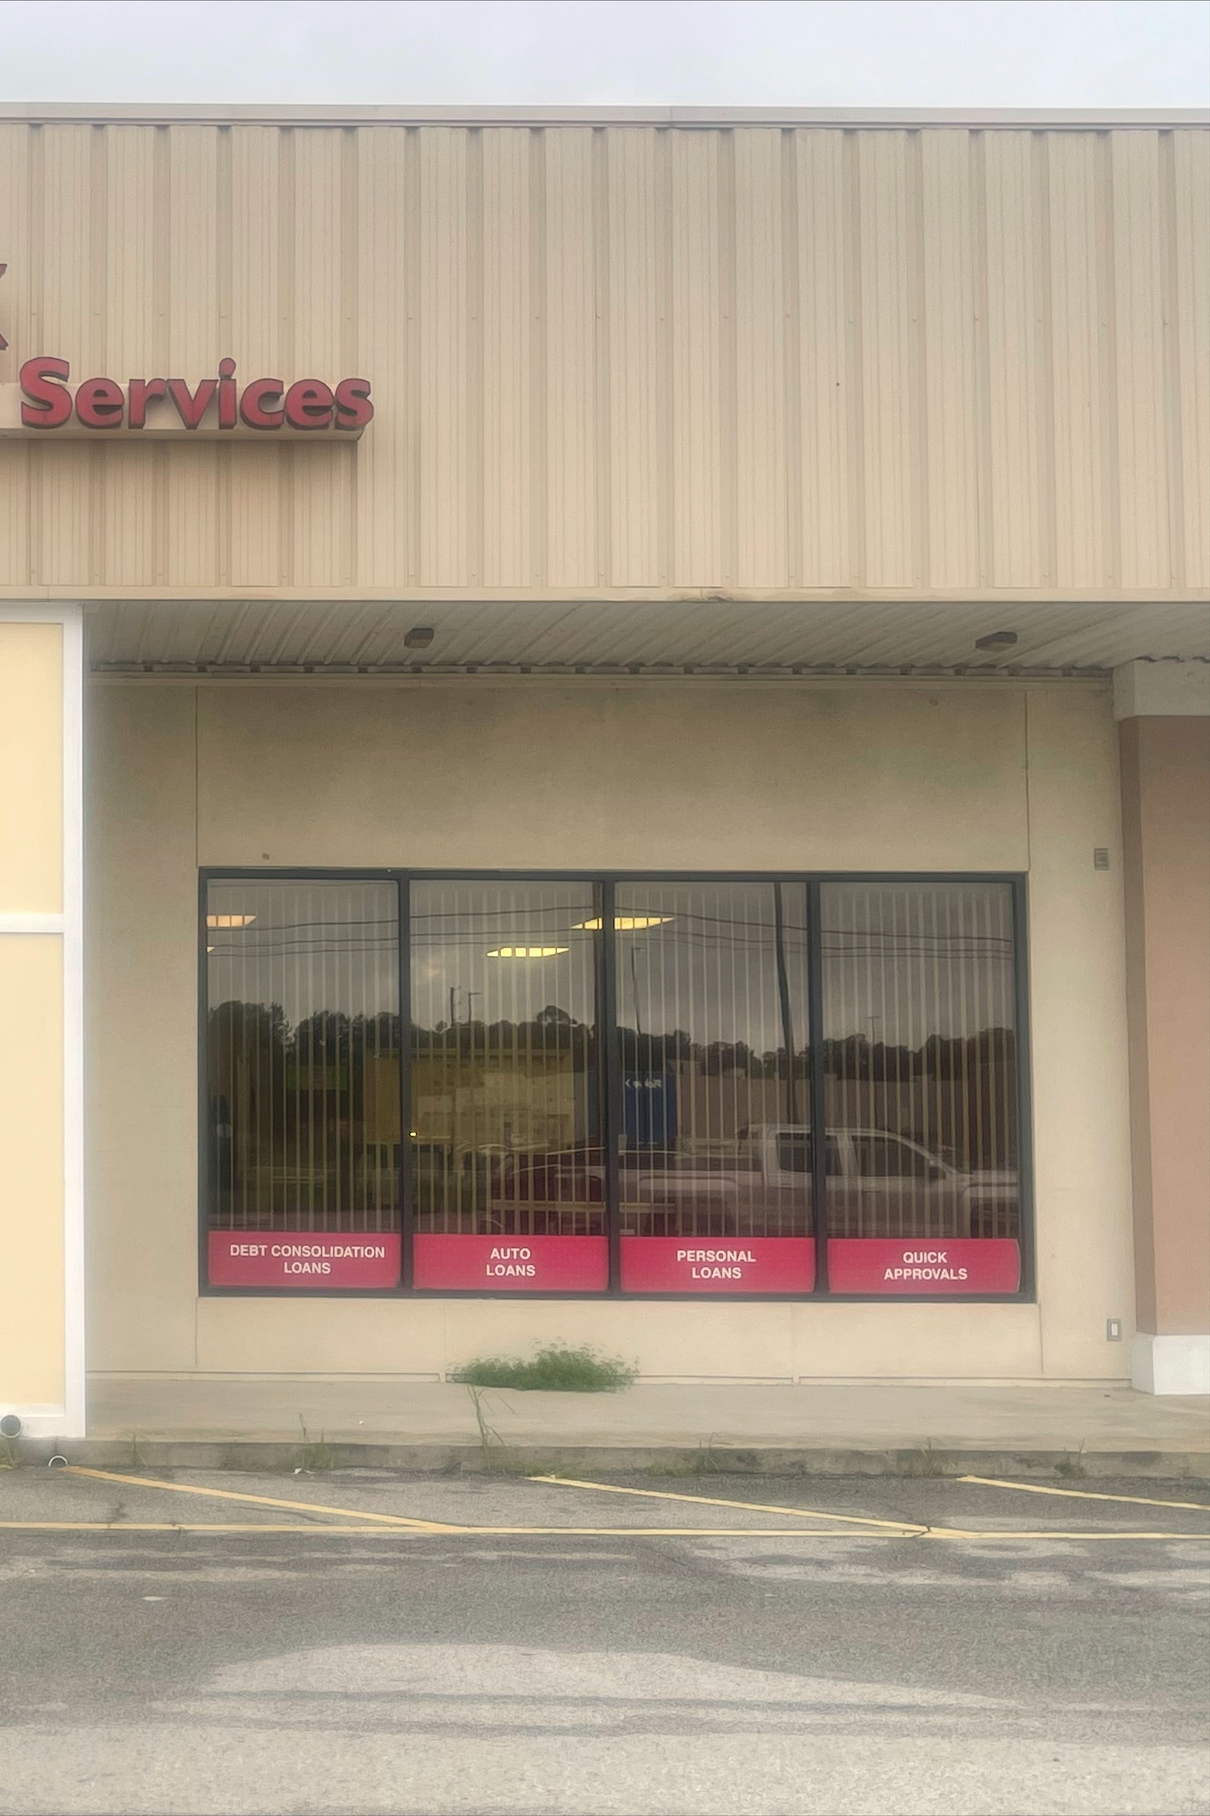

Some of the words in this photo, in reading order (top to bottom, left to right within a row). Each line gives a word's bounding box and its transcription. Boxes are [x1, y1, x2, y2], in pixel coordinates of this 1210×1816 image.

[19, 356, 375, 429] Services
[230, 1244, 267, 1257] DEBT
[271, 1245, 385, 1259] CONSOLIDATION
[490, 1247, 531, 1260] AUTO
[676, 1250, 757, 1262] PERSONAL
[902, 1250, 948, 1264] QUICK
[283, 1260, 331, 1274] LOANS
[486, 1264, 536, 1277] LOANS
[691, 1266, 742, 1279] LOANS
[884, 1267, 968, 1280] APPROVALS
